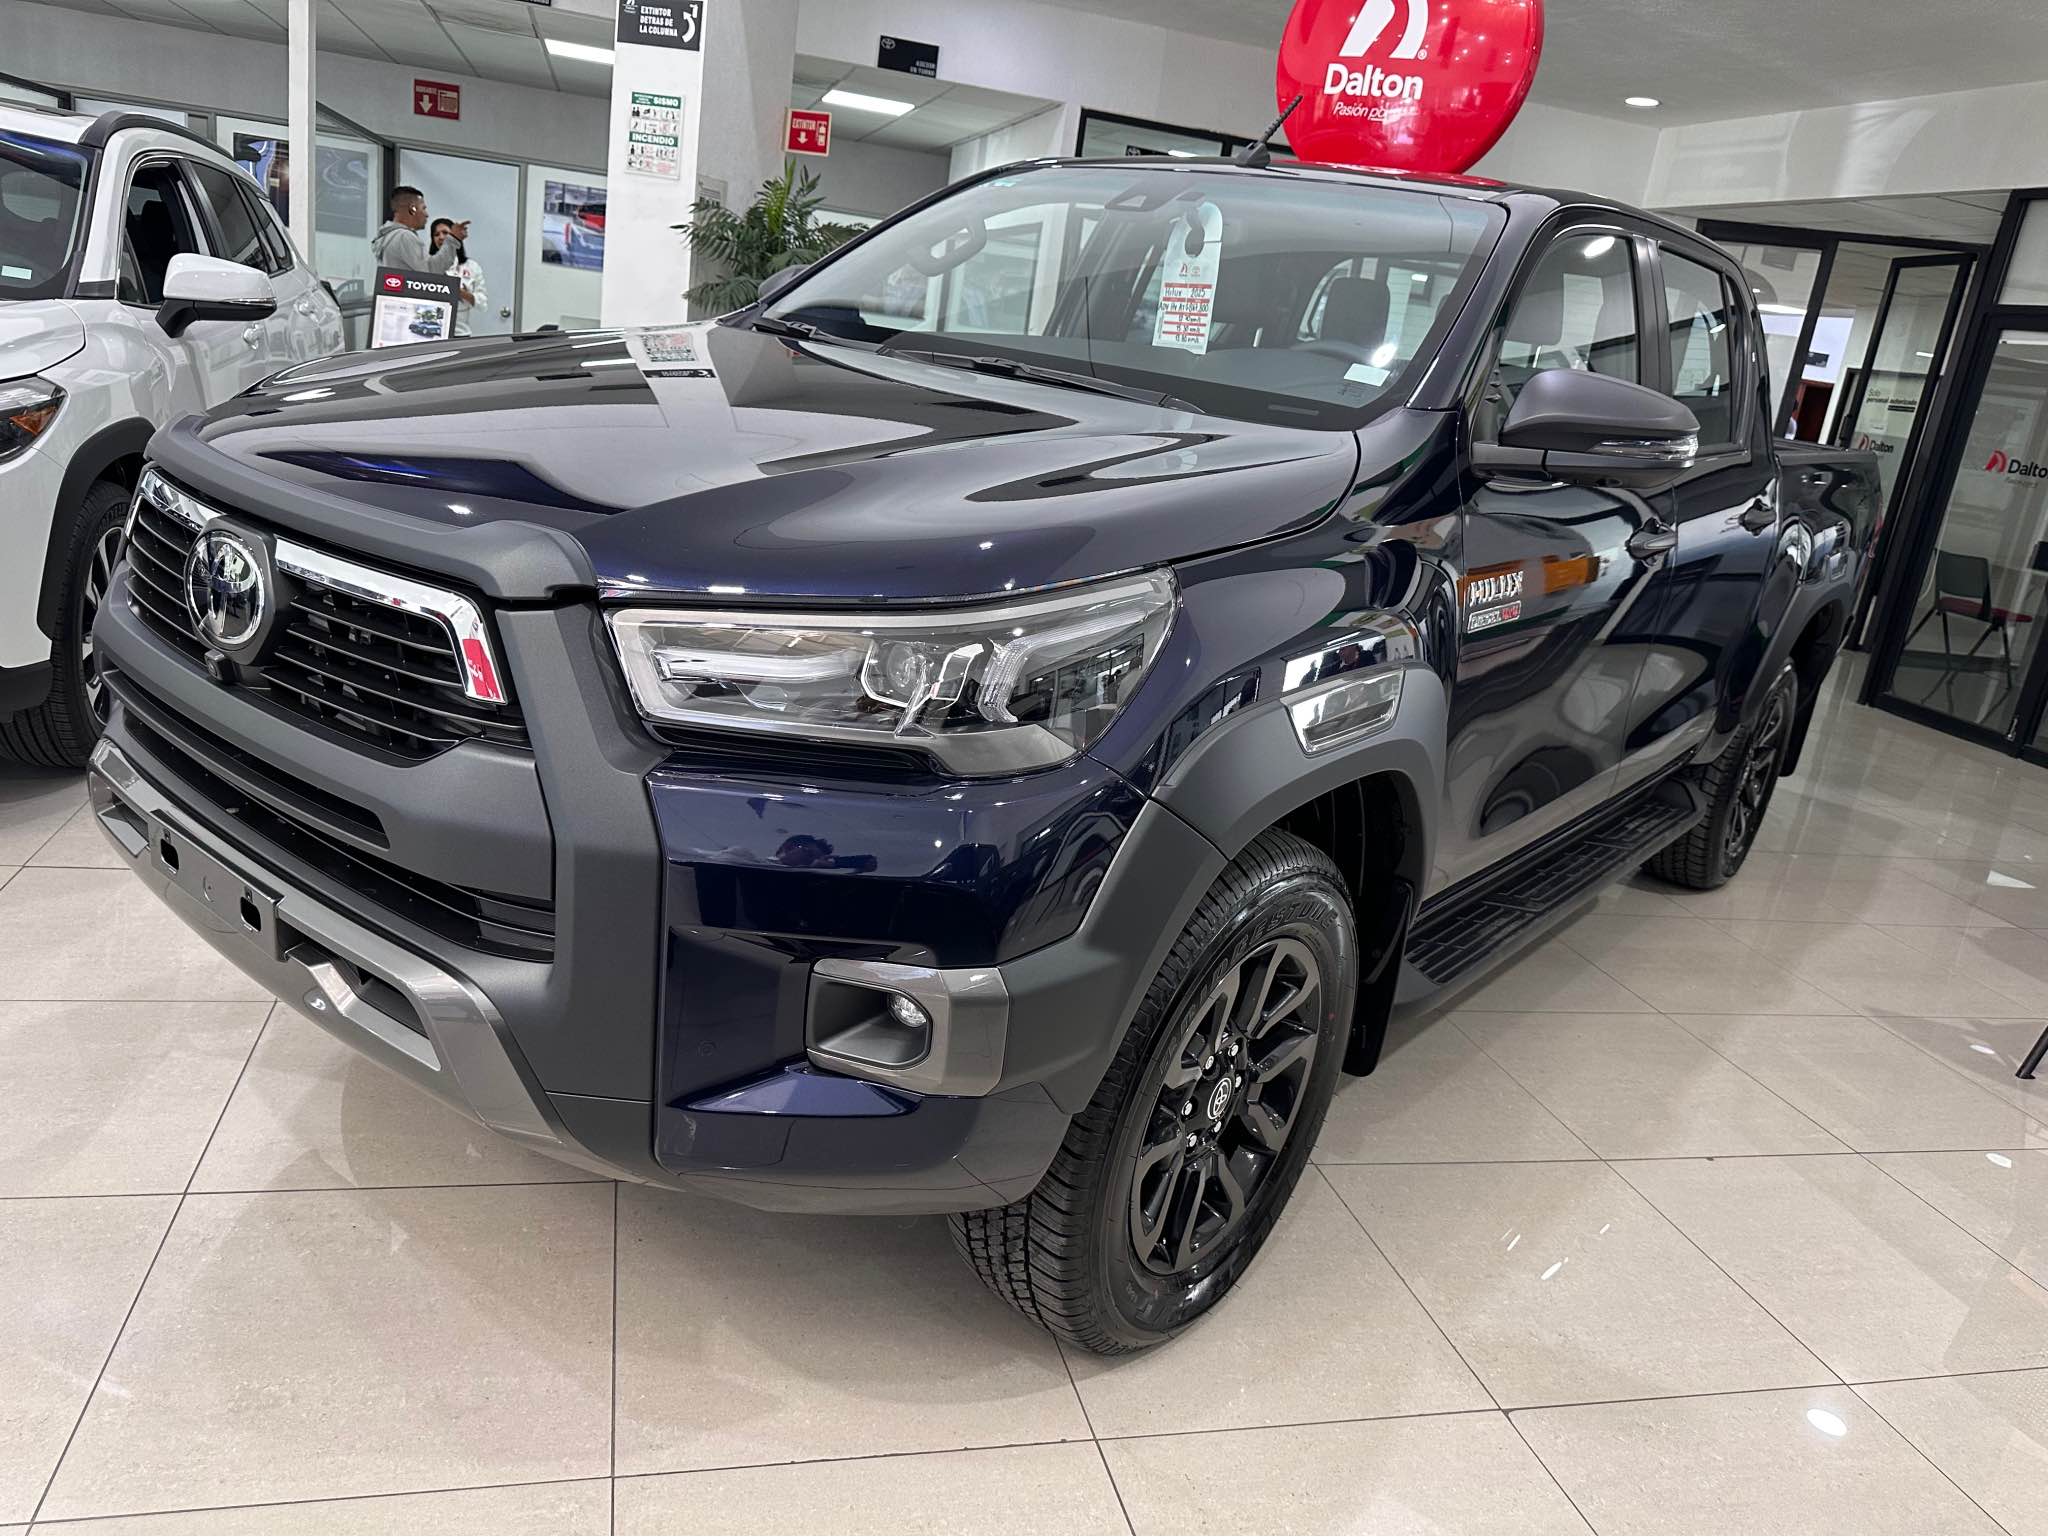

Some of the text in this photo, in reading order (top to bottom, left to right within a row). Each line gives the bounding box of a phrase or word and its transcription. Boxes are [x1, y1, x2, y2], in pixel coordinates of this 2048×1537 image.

[641, 6, 671, 17] EXTINTOR
[640, 15, 674, 27] DETRAS DE
[640, 25, 678, 37] LA COLUMNA
[1323, 63, 1424, 100] Dalton
[653, 96, 679, 107] SISMO
[1333, 102, 1368, 118] Pasión
[632, 132, 675, 146] INCENDIO
[406, 280, 451, 294] TOYOTA
[1871, 440, 1894, 453] Dalton
[2008, 459, 2048, 478] Dalto
[1469, 571, 1523, 607] HILUX
